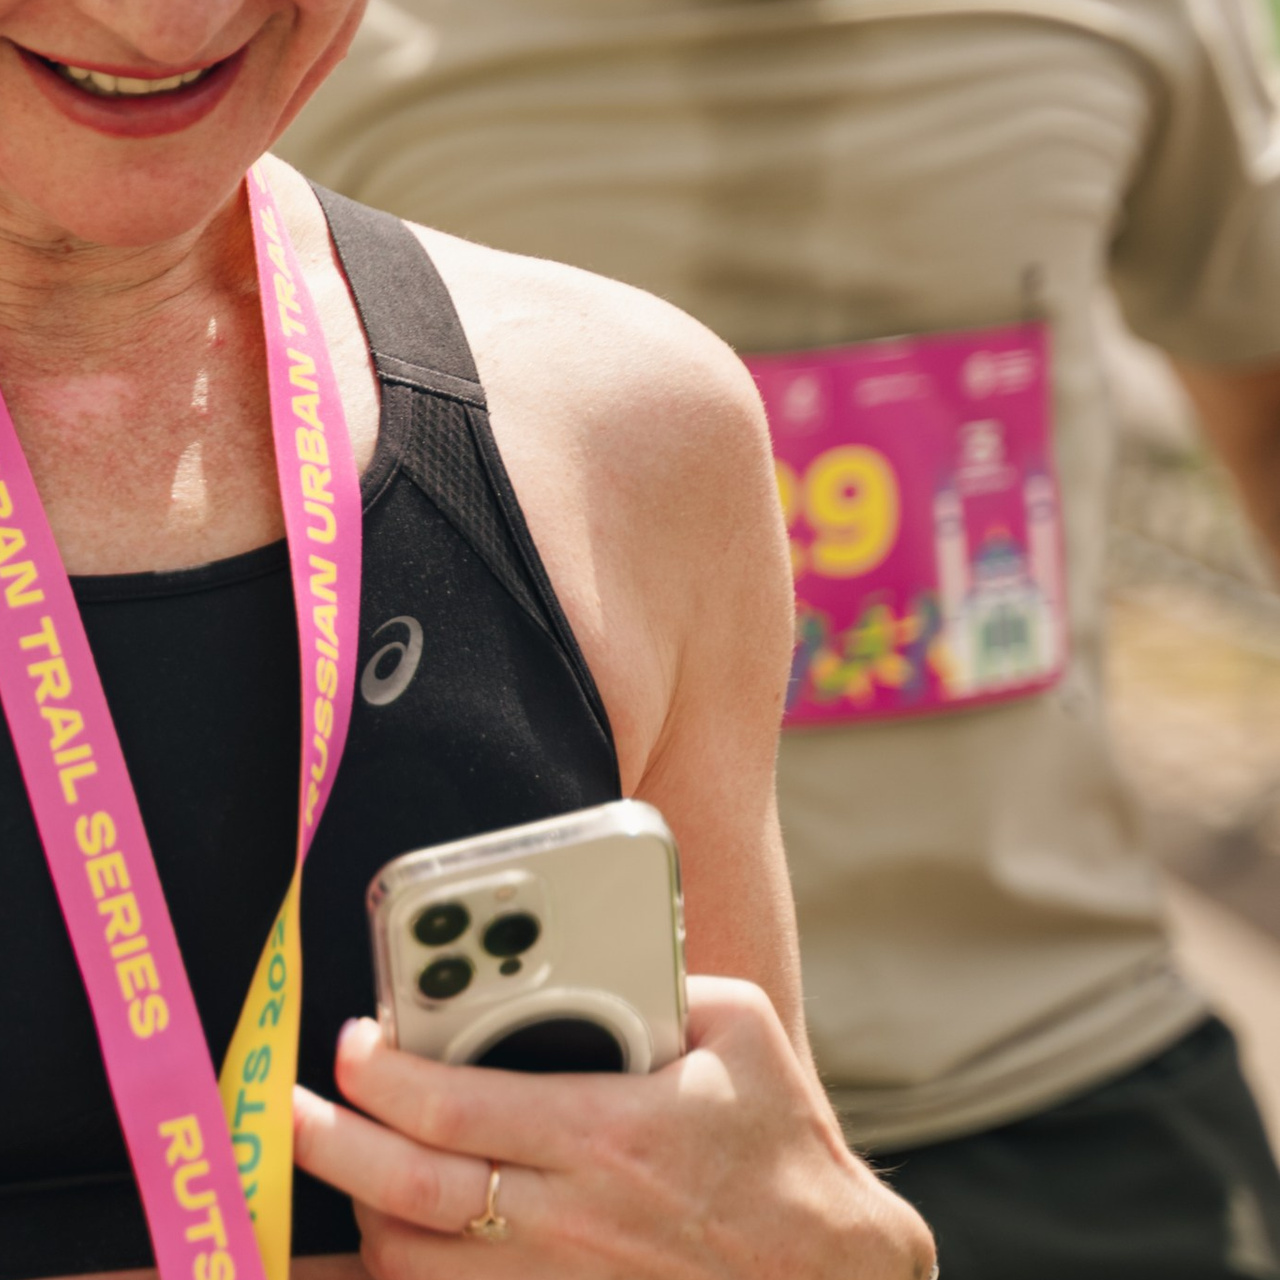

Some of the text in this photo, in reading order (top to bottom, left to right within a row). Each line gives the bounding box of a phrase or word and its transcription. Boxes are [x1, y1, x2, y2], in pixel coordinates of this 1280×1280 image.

[286, 347, 338, 545] URBAN
[19, 616, 99, 804] TRAIL
[74, 811, 169, 1039] SERIES
[230, 1043, 273, 1223] UTS
